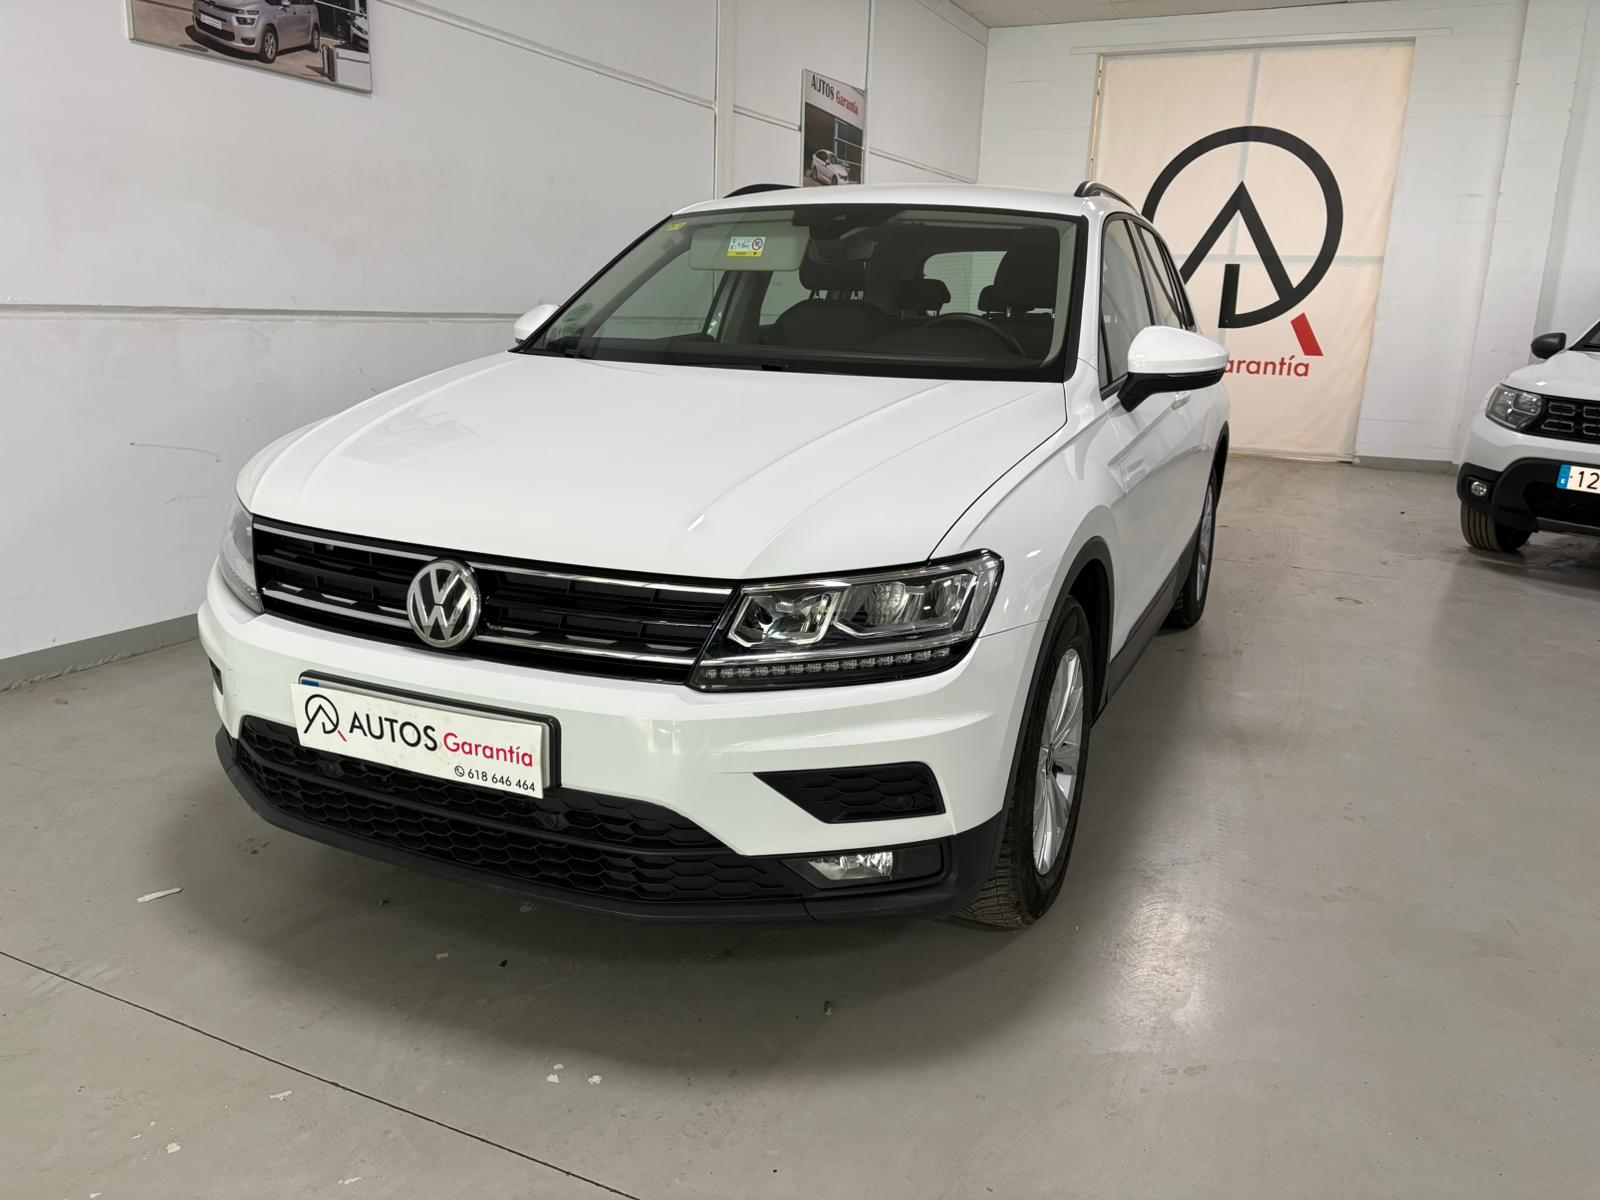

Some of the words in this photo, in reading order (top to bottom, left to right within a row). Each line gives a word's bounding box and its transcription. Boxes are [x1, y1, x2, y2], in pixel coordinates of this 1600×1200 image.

[811, 74, 835, 101] AUTOS
[1223, 354, 1310, 377] arantía
[349, 711, 438, 752] AUTOS
[443, 732, 533, 767] Garantía
[467, 768, 489, 782] 618
[491, 773, 512, 787] 646
[515, 779, 536, 792] 464
